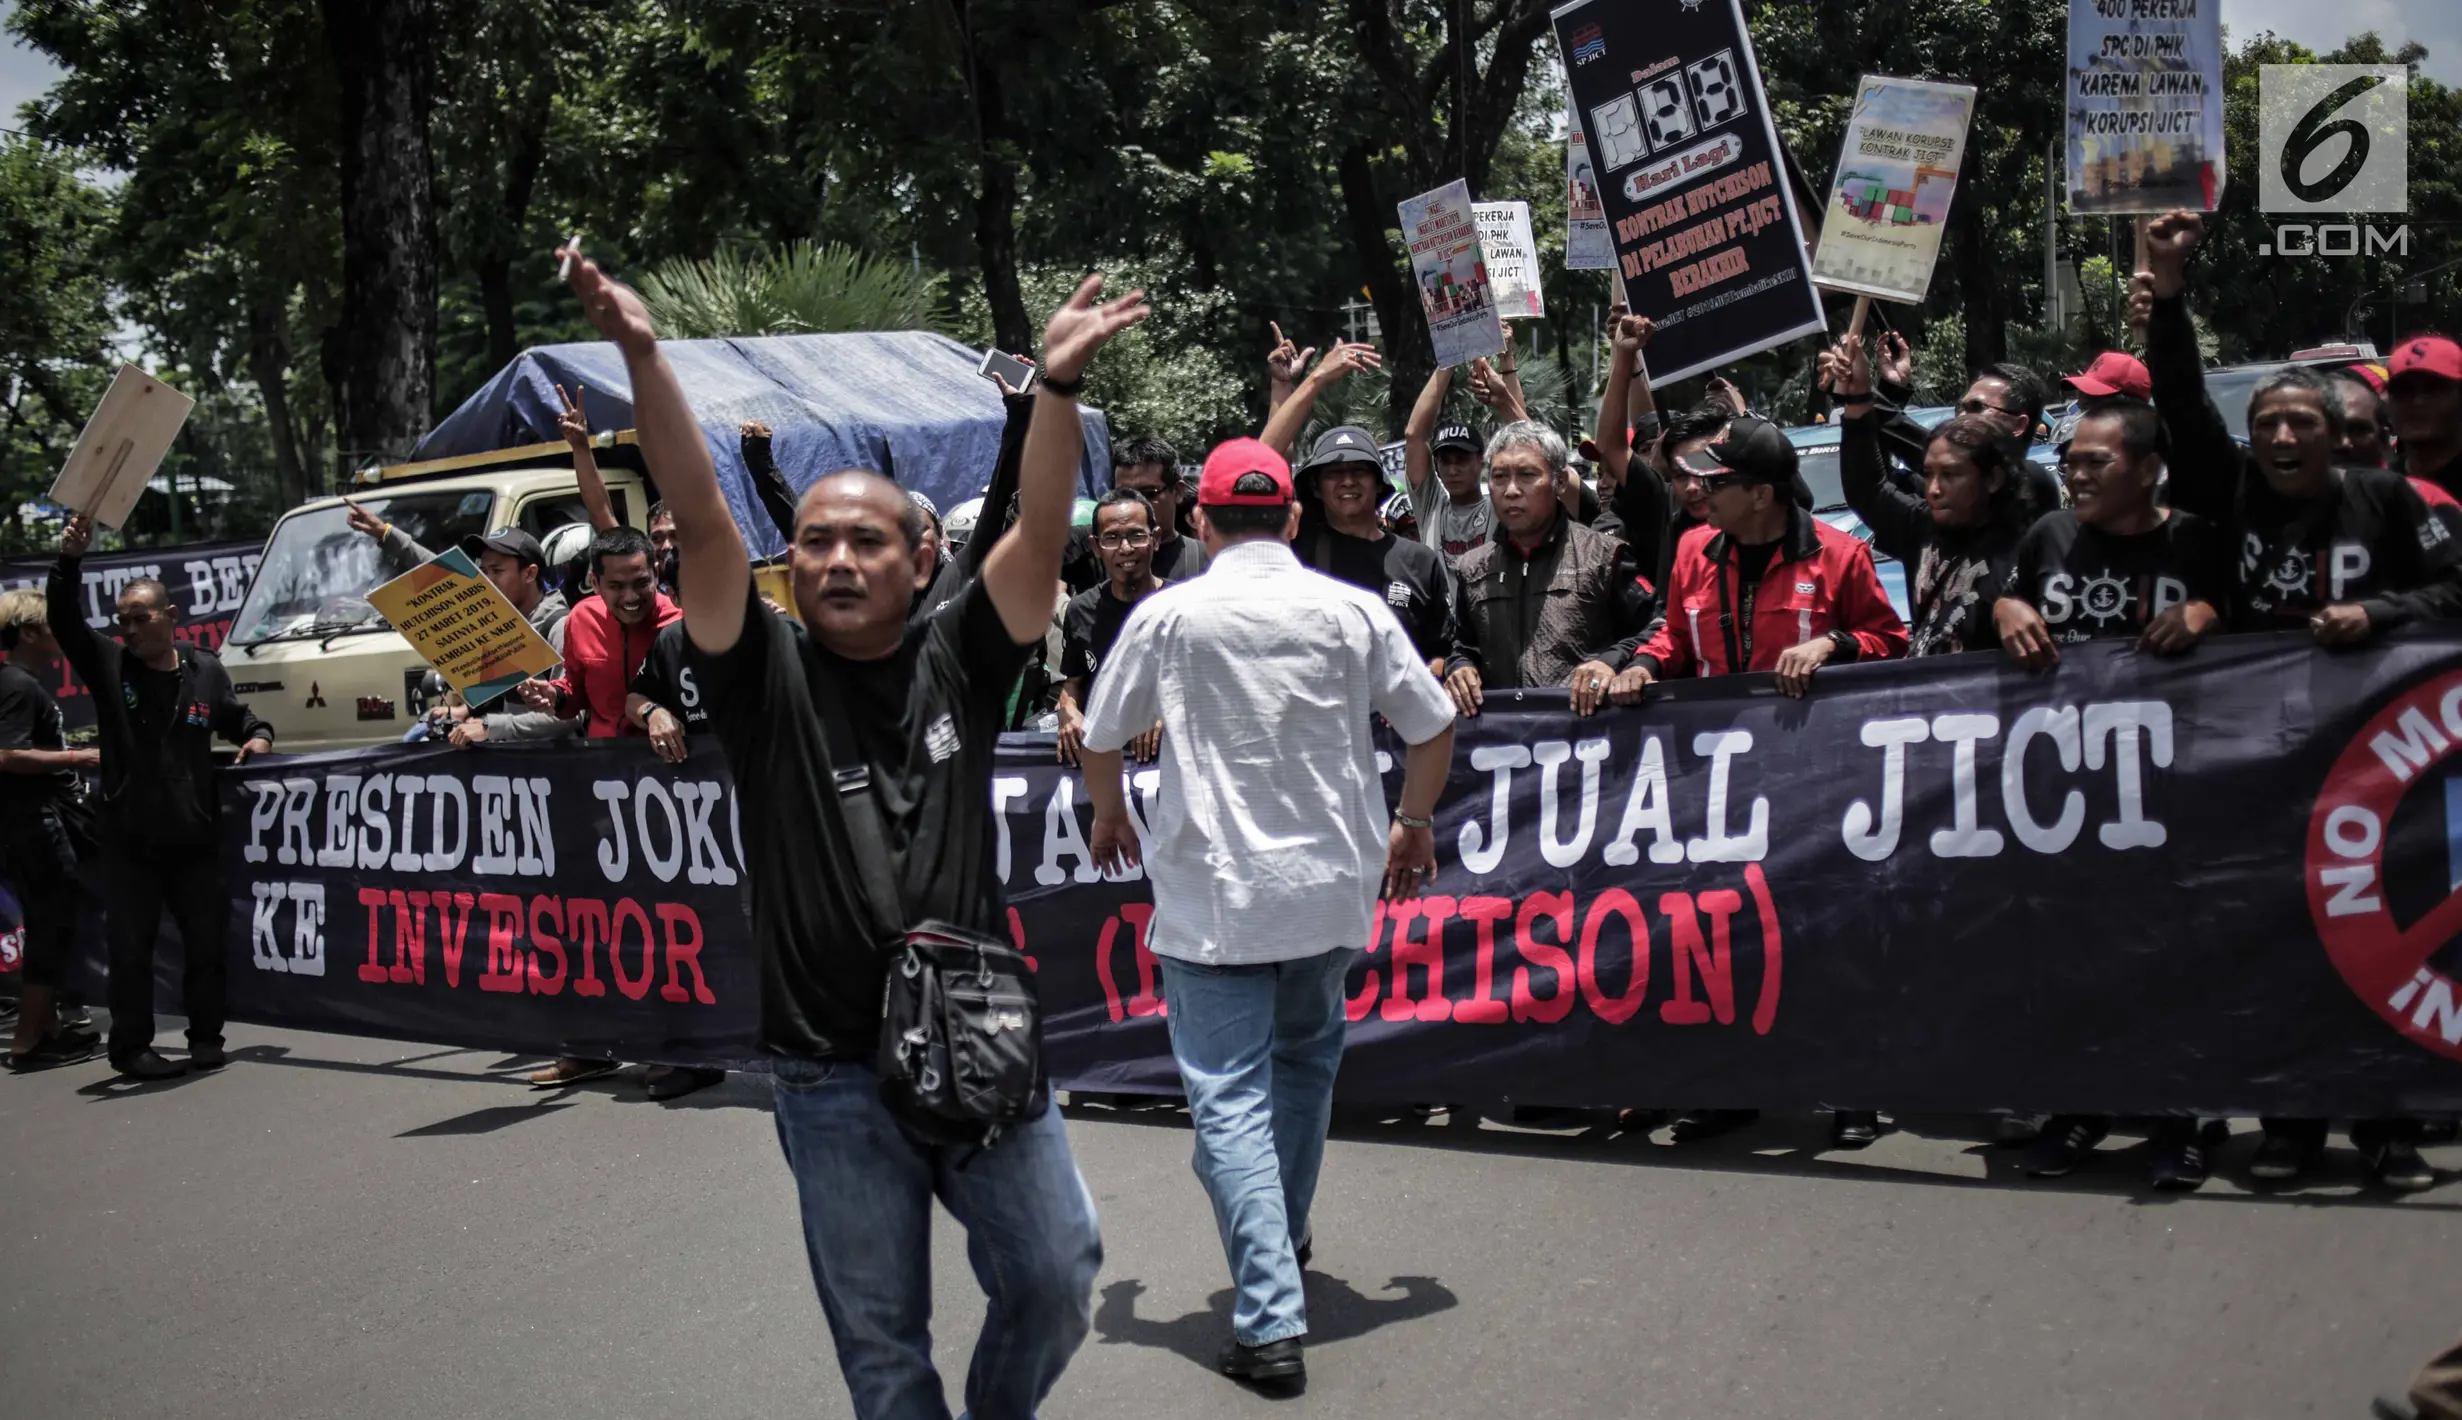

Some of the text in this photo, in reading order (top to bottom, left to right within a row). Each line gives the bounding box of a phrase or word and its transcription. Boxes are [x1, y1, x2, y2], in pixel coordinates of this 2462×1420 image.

[2101, 35, 2185, 58] SPC DI PHK
[1631, 56, 1680, 83] Dalam
[2079, 72, 2203, 97] KARENA LAWAN
[2086, 111, 2155, 135] KORUPSI
[1859, 142, 1911, 159] KONTRAK
[1905, 131, 1956, 149] KORUPSI
[1633, 140, 1732, 194] Hari Lagi
[1616, 160, 1773, 244] KONTRAK HUTCHISON
[1491, 229, 1509, 241] PHK
[1621, 251, 1643, 280] DI
[1640, 217, 1728, 273] PELABUHAN
[1490, 248, 1522, 260] LAWAN
[1669, 246, 1750, 299] BERAKHIR
[1438, 425, 1470, 441] MUA
[1808, 446, 1840, 456] BIRD
[400, 582, 487, 631] HUTCHISON HABIS
[414, 629, 430, 641] 27
[431, 611, 464, 632] MARET
[435, 611, 500, 649] SAATNYA JICT
[433, 641, 477, 667] KEMBALI
[475, 633, 491, 647] KE
[243, 773, 556, 877] PRESIDEN
[593, 776, 747, 885] JOK
[1458, 731, 1770, 874] JUAL
[1842, 701, 2174, 861] JICT
[2319, 804, 2382, 917] NO
[252, 882, 325, 976] KE
[358, 887, 716, 1004] INVESTOR
